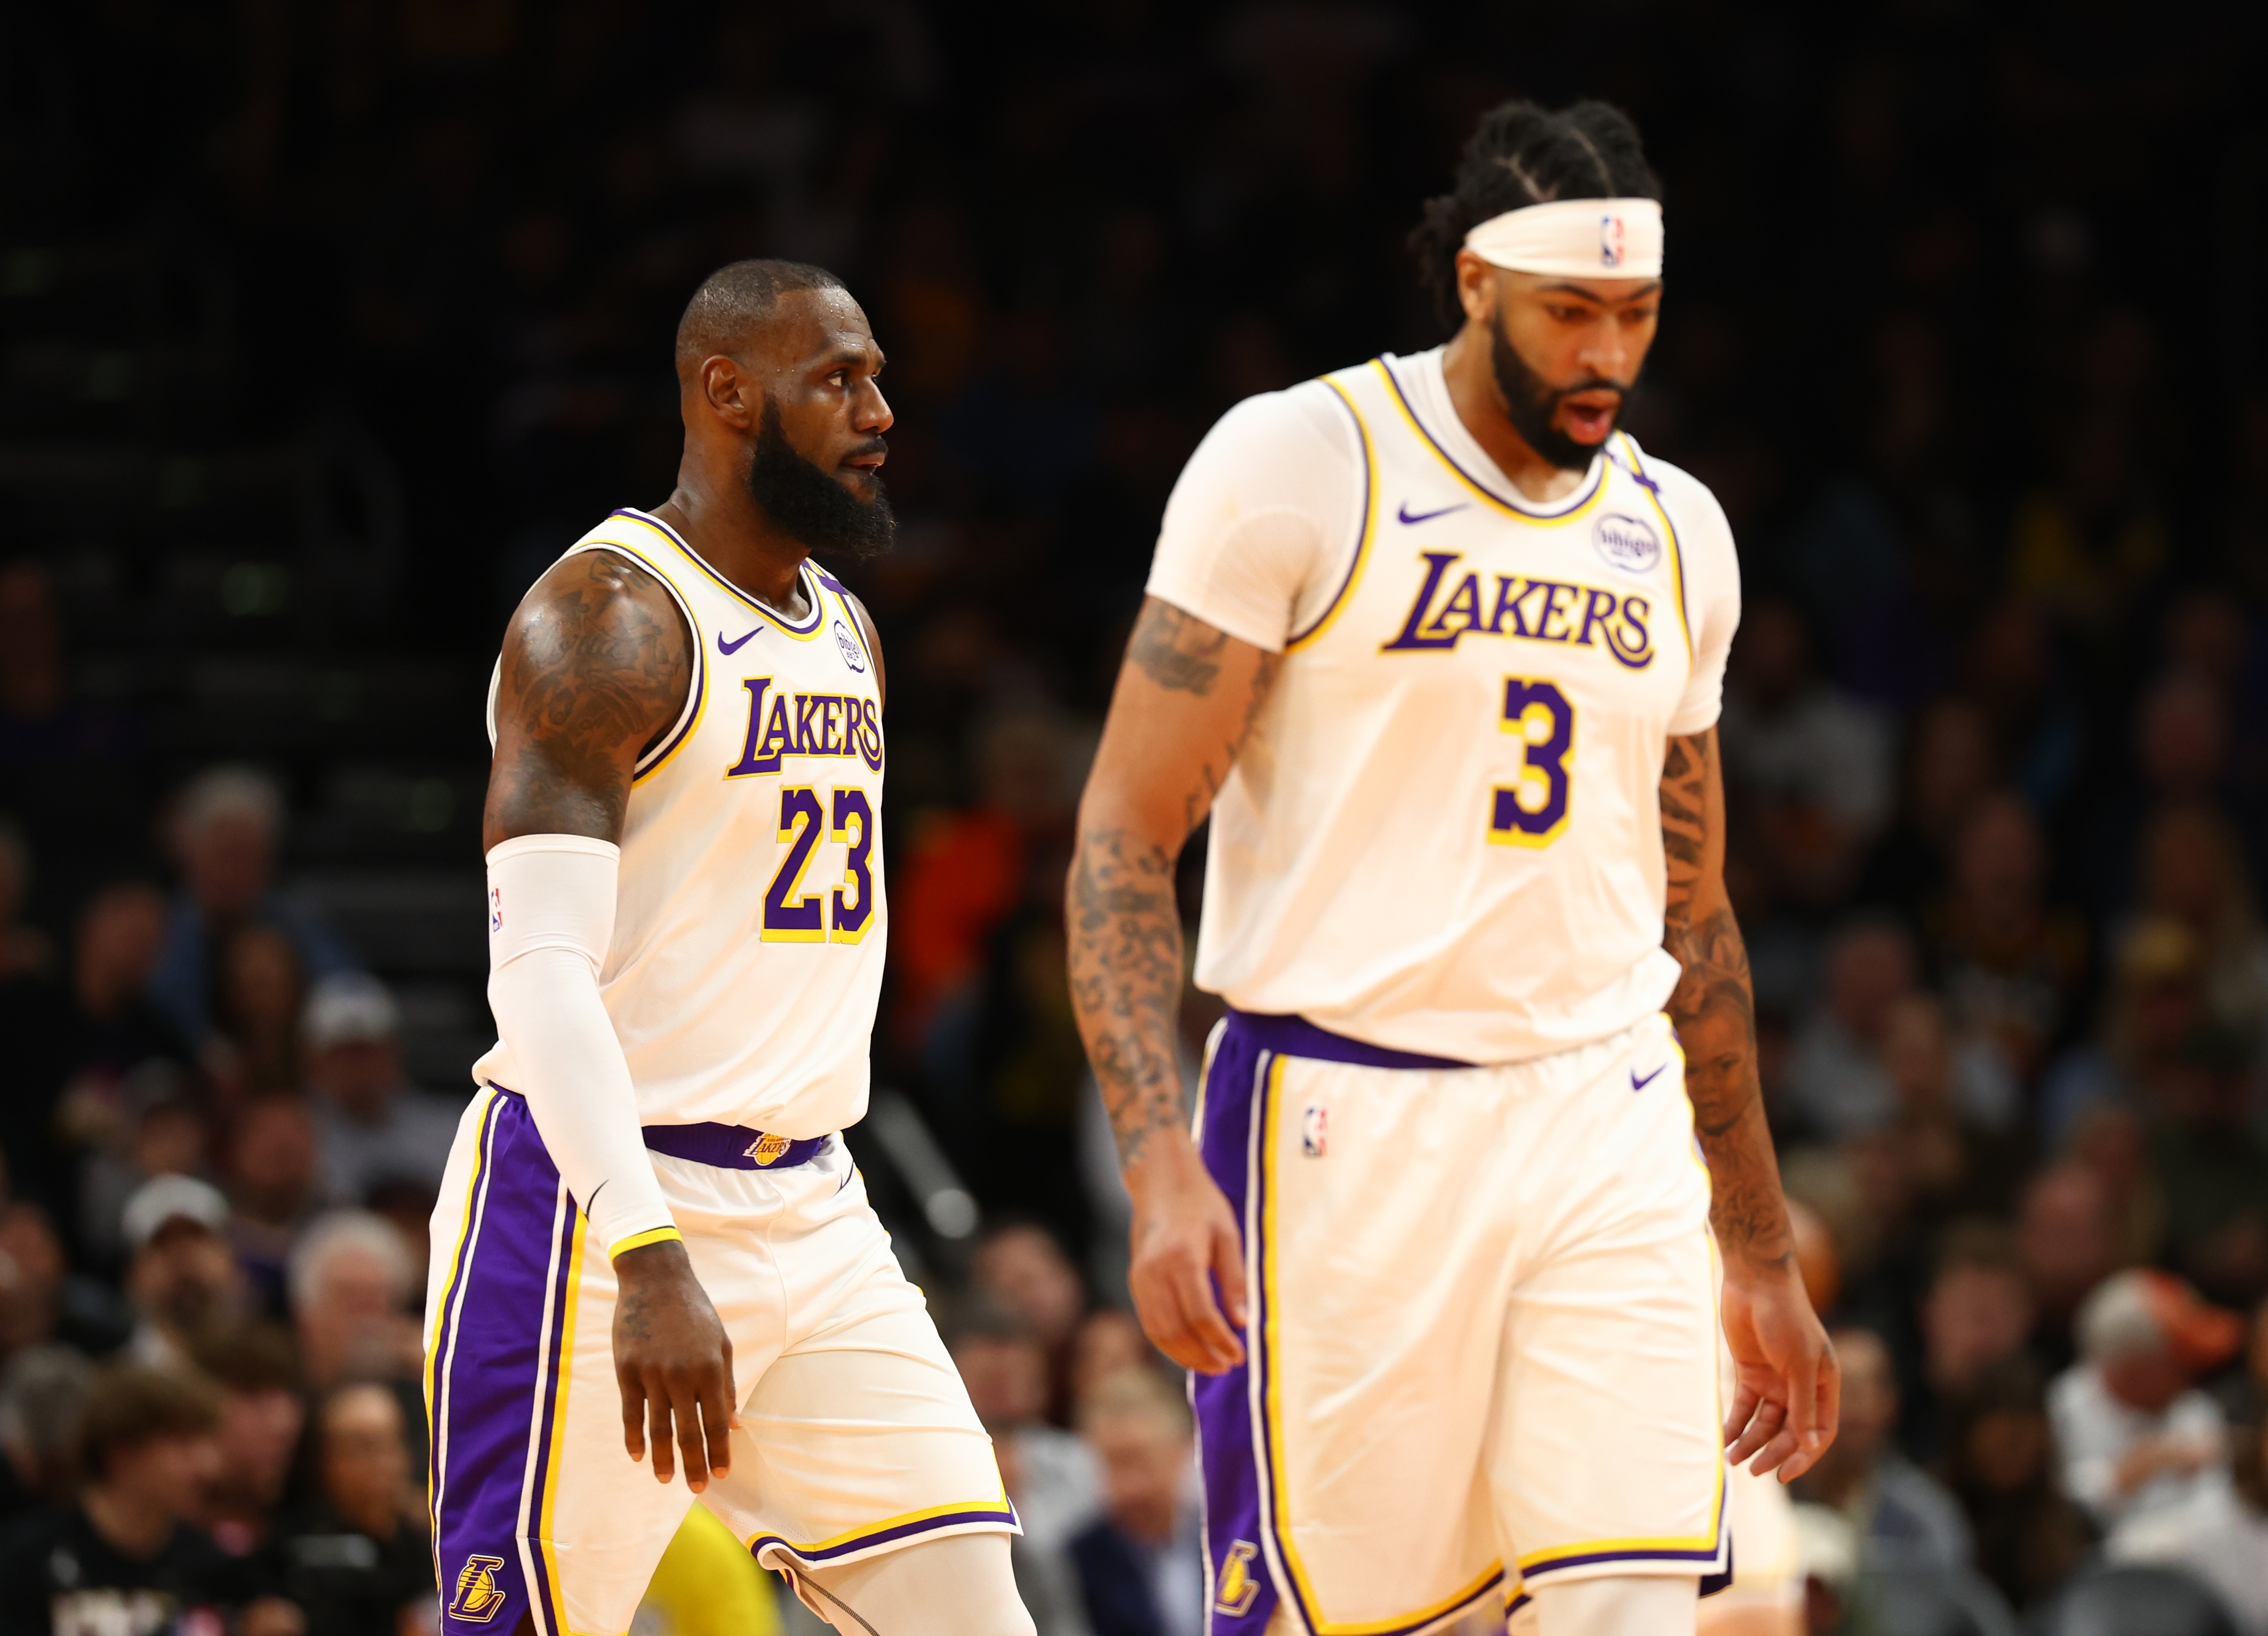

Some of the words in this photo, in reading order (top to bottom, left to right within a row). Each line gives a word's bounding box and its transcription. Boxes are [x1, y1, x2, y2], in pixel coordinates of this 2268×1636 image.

[1379, 548, 1655, 671] LAKERS
[723, 675, 884, 780] LAKERS
[1486, 674, 1575, 849] 3
[761, 785, 875, 945] 23
